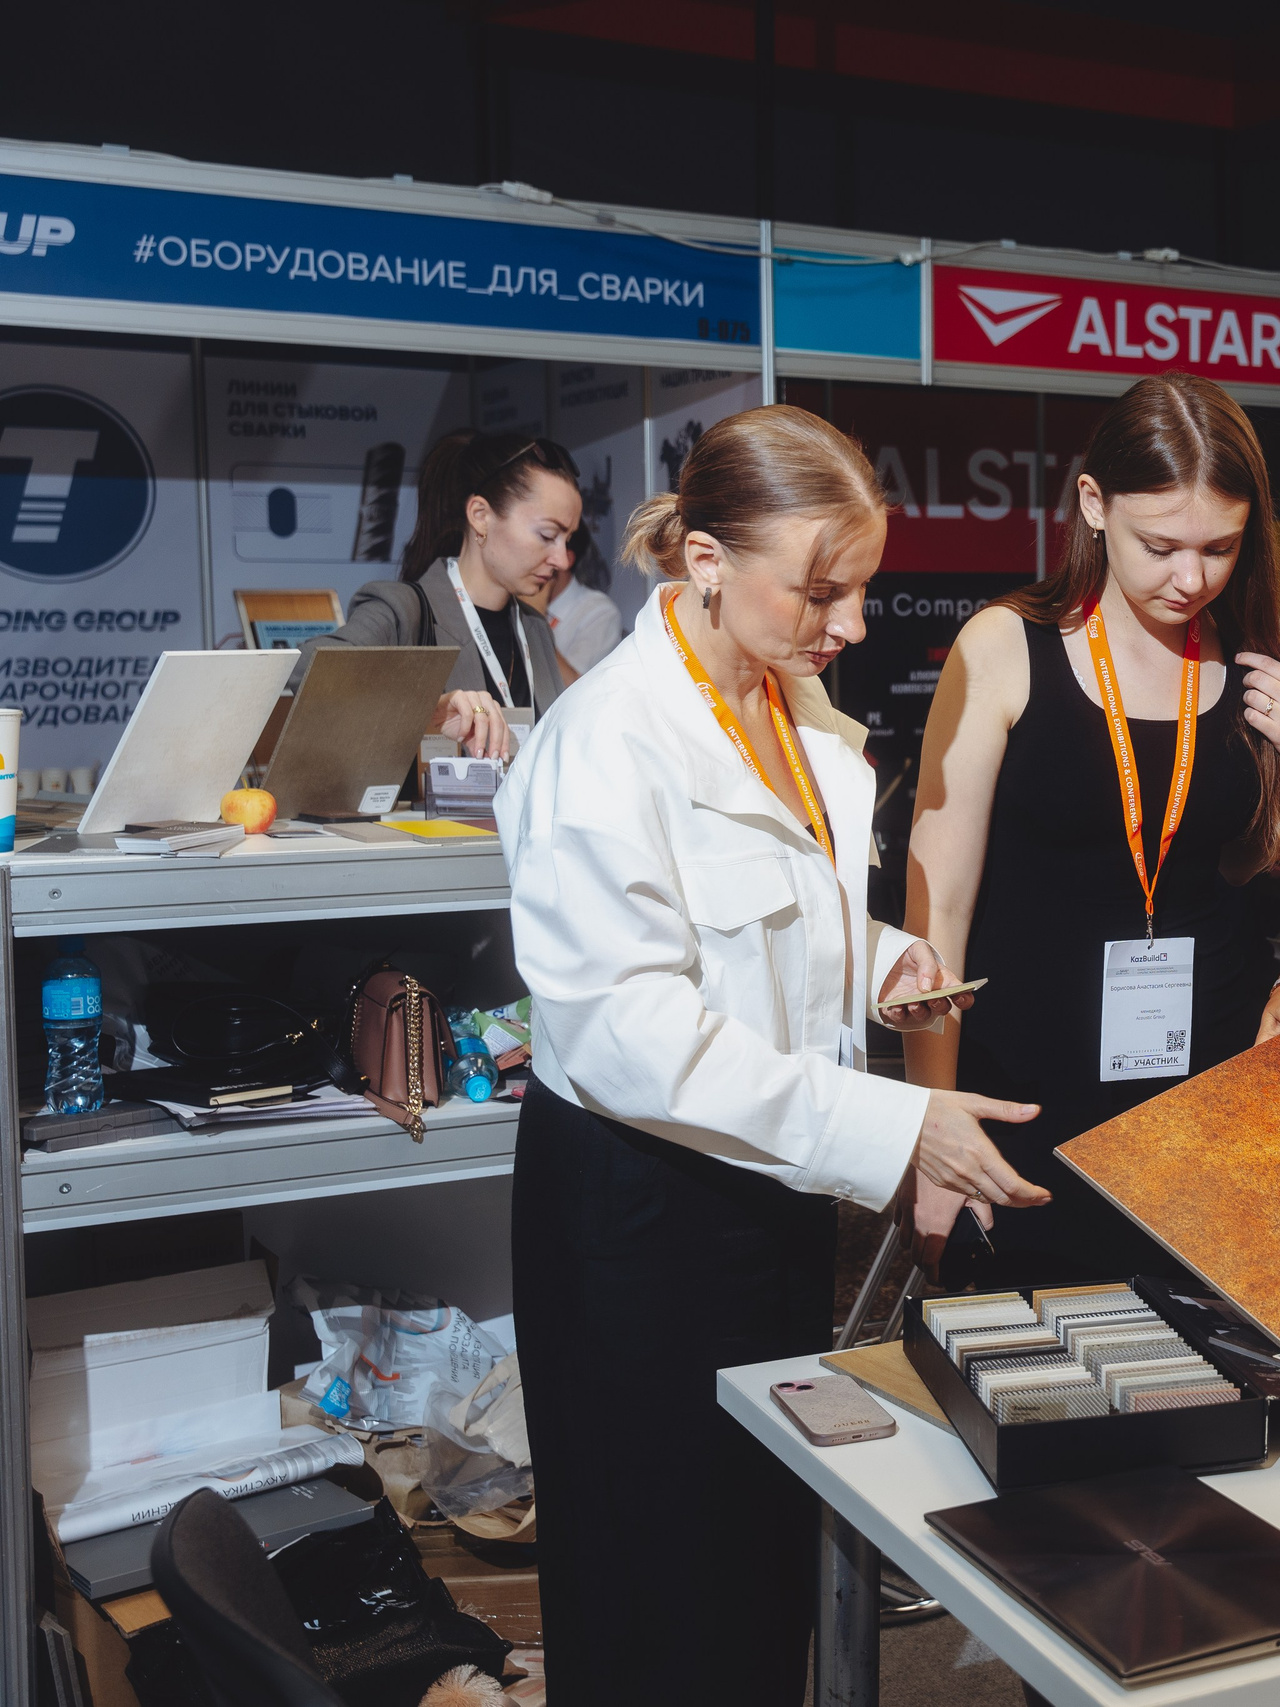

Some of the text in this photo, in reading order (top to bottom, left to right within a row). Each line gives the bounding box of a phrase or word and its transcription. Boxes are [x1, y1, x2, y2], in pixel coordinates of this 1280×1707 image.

[133, 233, 705, 308] #ОБОРУДОВАНИЕ_ДЛЯ_СВАРКИ
[272, 403, 378, 422] СТЫКОВОЙ
[227, 421, 307, 439] СВАРКИ
[73, 609, 181, 633] GROUP
[473, 625, 492, 657] VISITOR
[774, 706, 798, 766] CONFERENCES
[1098, 657, 1138, 833] INTERNATIONAL EXHIBITIONS & CONFERENCES
[1168, 660, 1195, 832] INTERNATIONAL EXHIBITIONS & CONFERENCES
[798, 774, 824, 827] EXHIBITIONS
[1130, 954, 1160, 963] KazBuild
[1110, 984, 1136, 992] Борисова
[1134, 1056, 1179, 1067] УЧАСТНИК
[222, 1472, 287, 1499] АКУСТИКА
